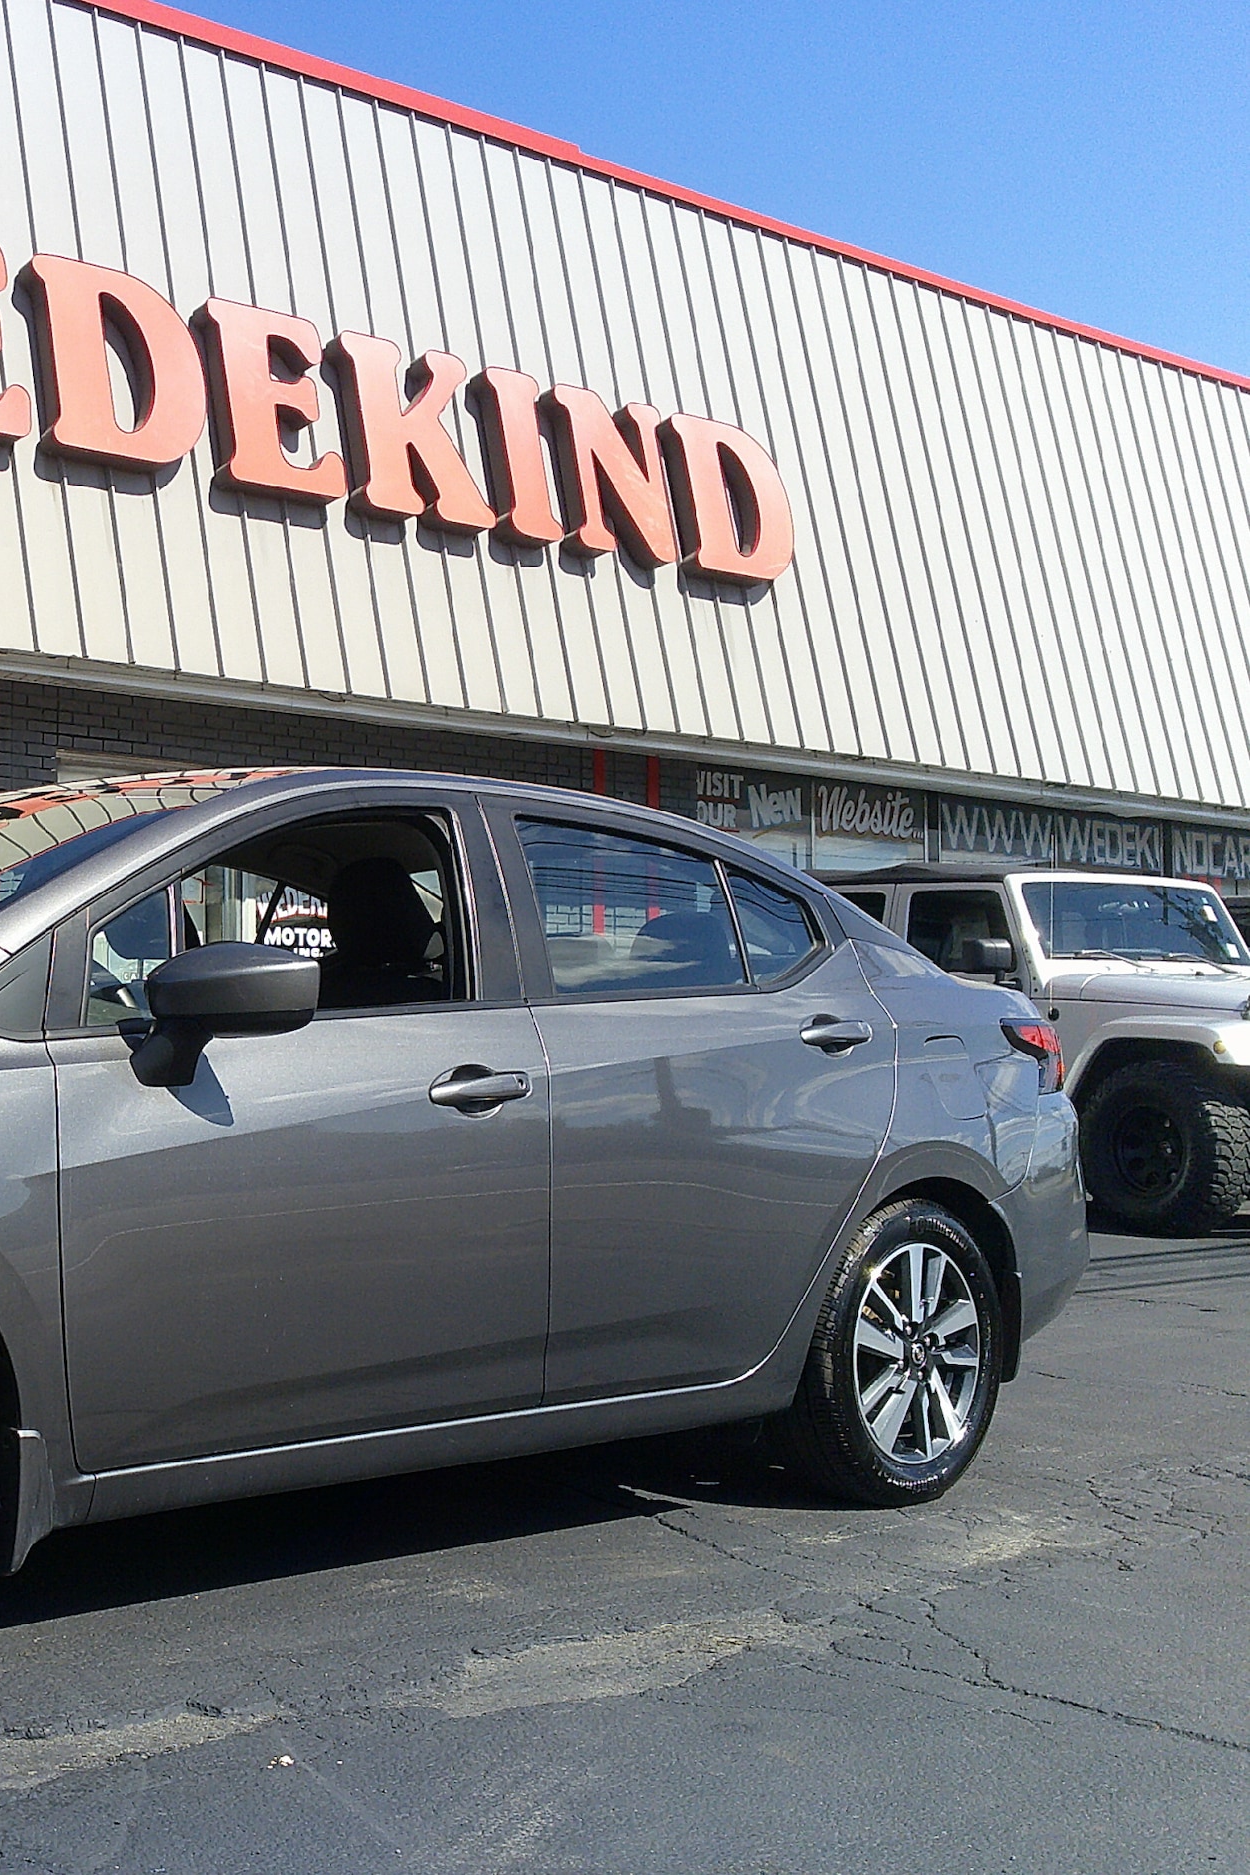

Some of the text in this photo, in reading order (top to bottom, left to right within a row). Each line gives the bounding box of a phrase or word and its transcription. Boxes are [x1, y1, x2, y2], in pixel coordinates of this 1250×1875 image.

[695, 770, 745, 799] VISIT
[695, 800, 737, 828] OUR
[747, 783, 802, 828] New
